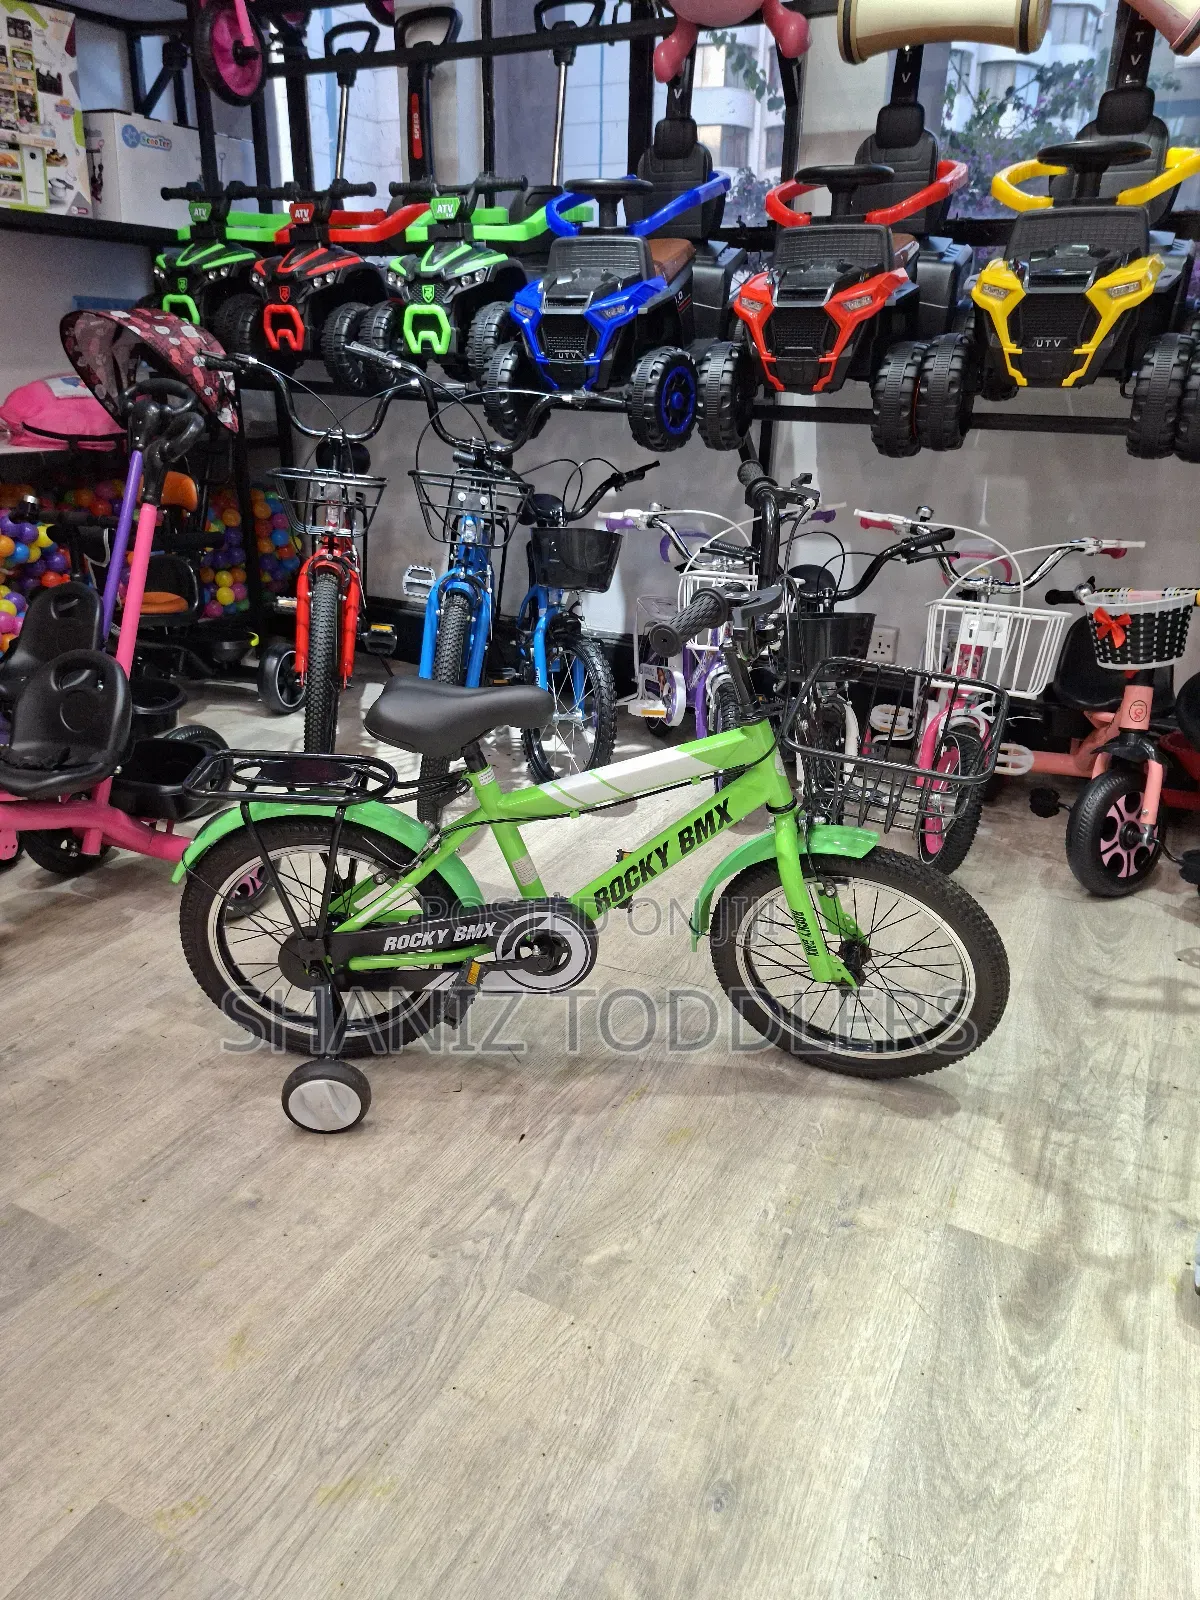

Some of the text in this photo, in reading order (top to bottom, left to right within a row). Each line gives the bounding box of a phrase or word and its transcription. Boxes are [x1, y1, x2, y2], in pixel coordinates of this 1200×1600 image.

[193, 208, 207, 218] ATV
[294, 208, 309, 218] ATV
[437, 204, 453, 214] ATV
[1036, 339, 1062, 348] UTV
[593, 840, 670, 915] ROCKY
[677, 797, 734, 856] BMX
[383, 921, 497, 952] ROCKY BMX
